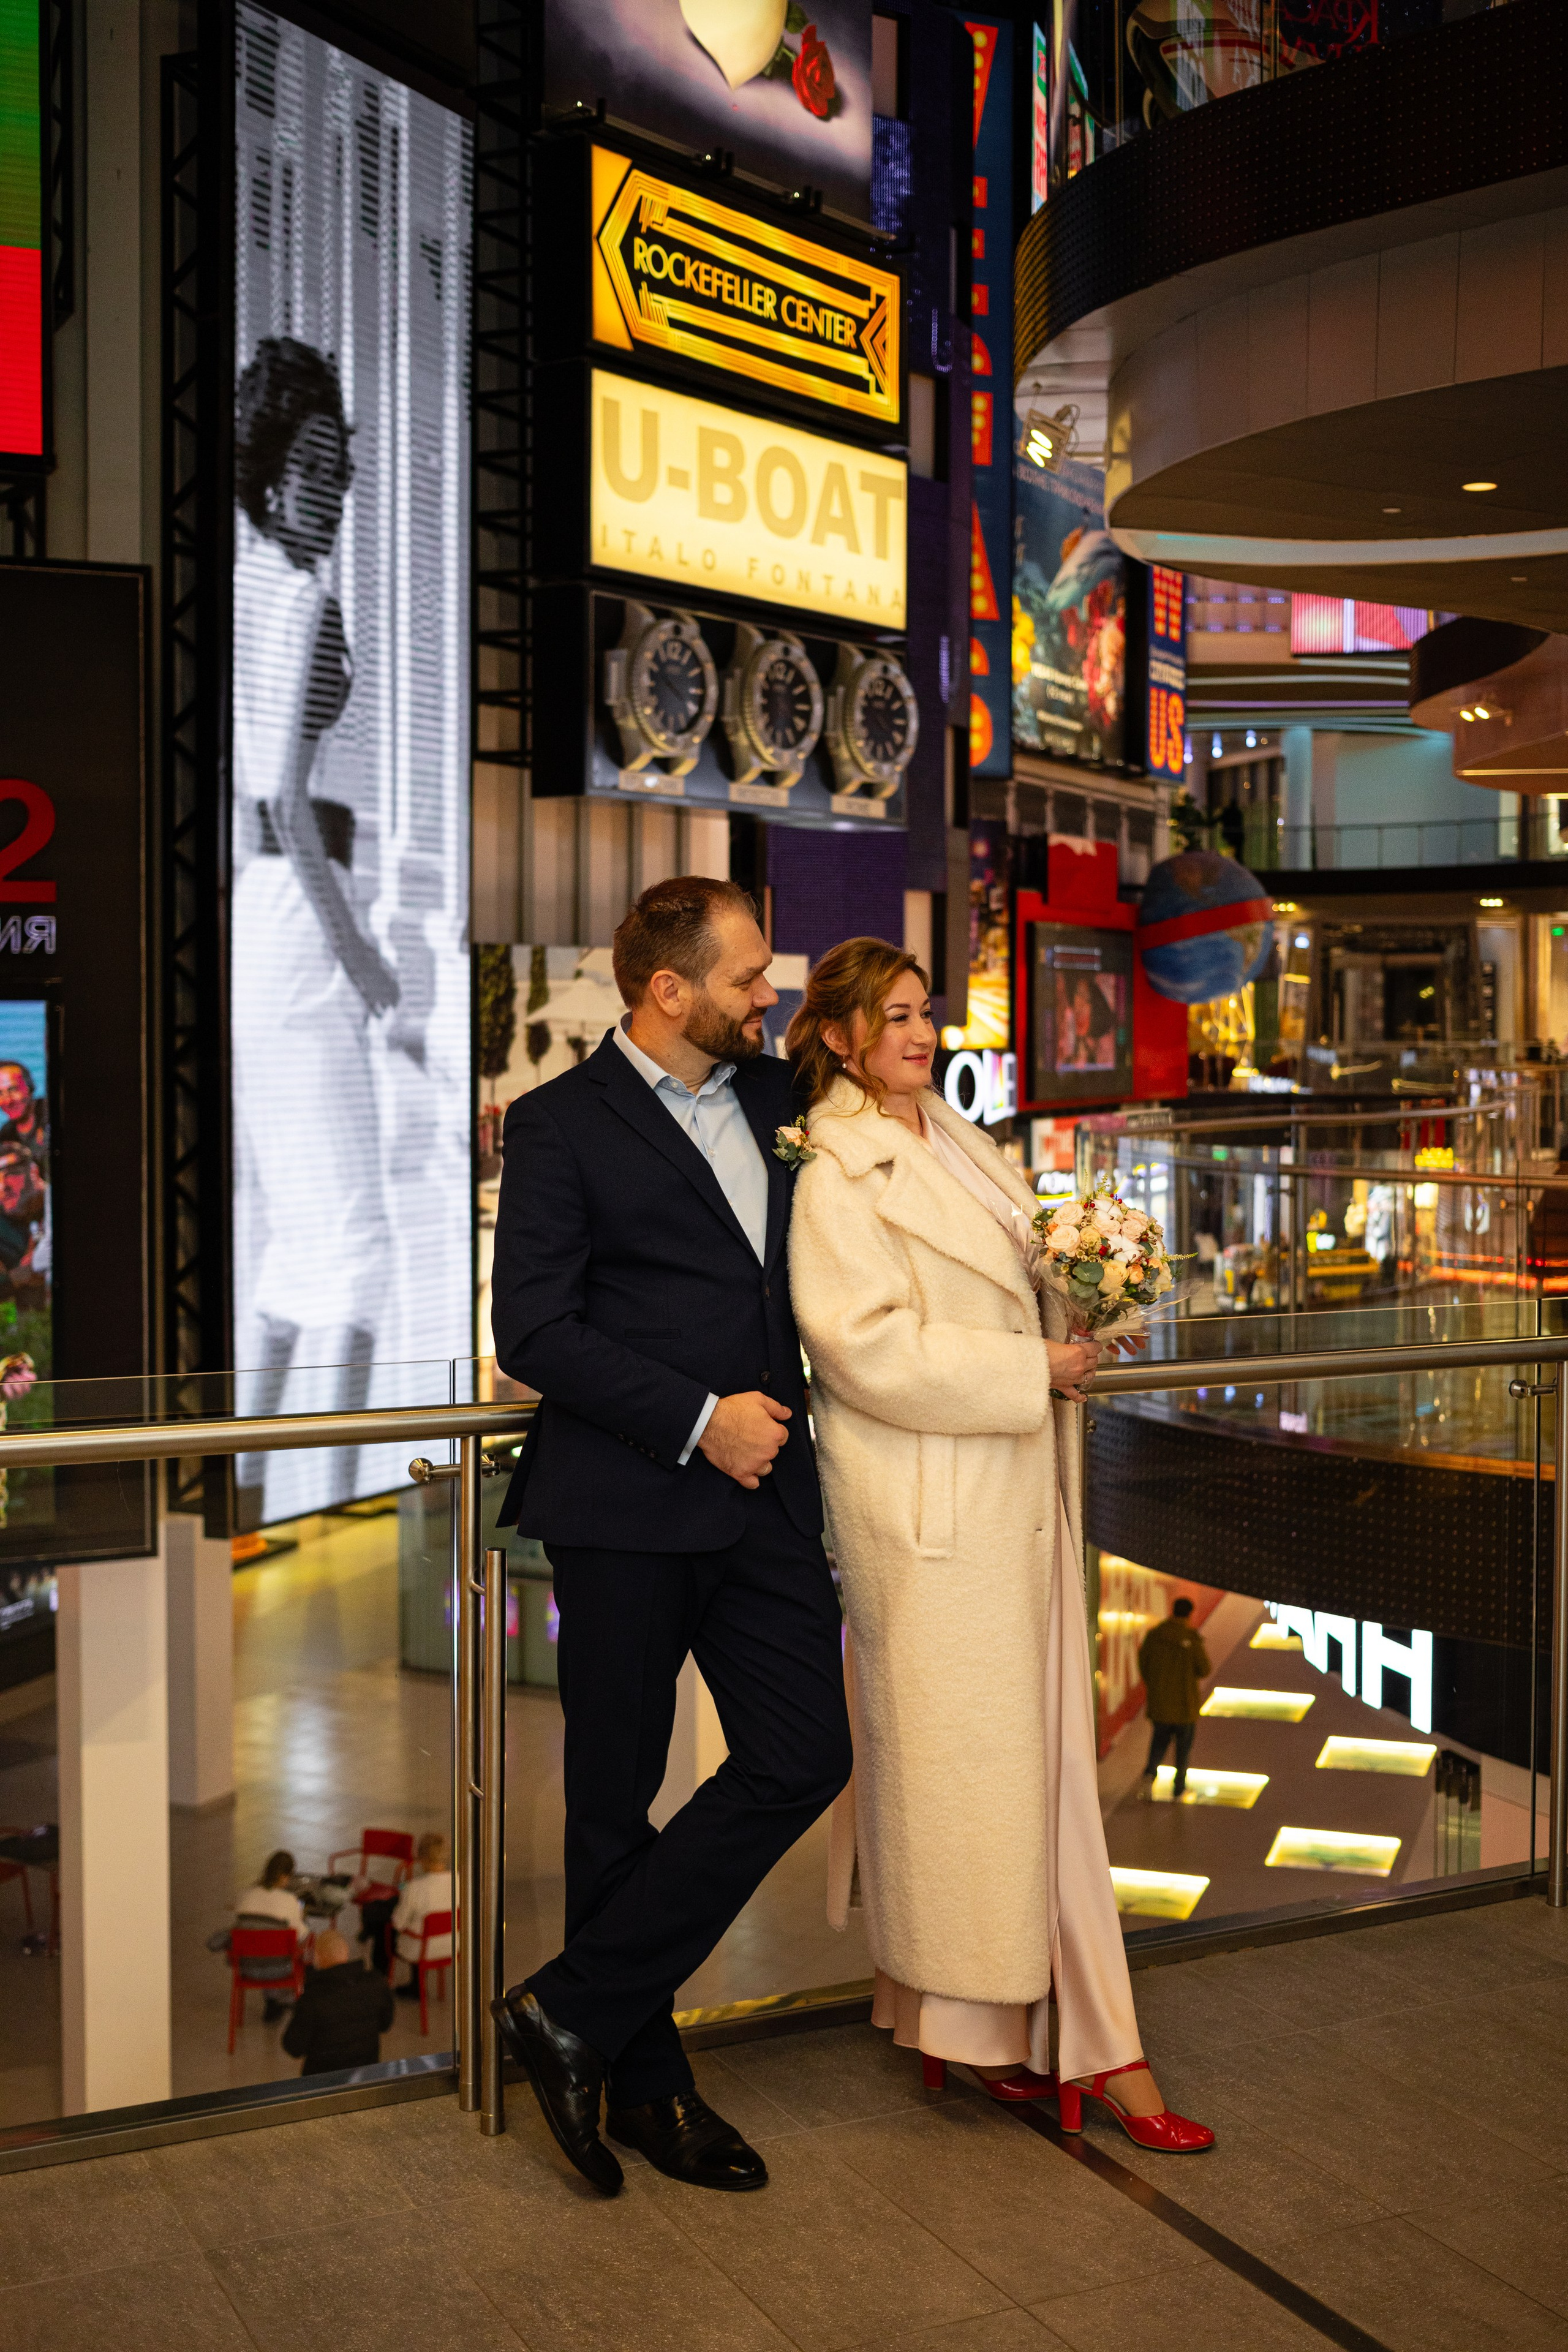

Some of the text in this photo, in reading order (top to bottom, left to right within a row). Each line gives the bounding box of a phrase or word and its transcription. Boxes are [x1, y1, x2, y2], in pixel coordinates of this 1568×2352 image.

[633, 236, 858, 349] ROCKEFELLER CENTER
[601, 396, 903, 561] U-BOAT
[600, 524, 904, 611] ITALO FONTANA
